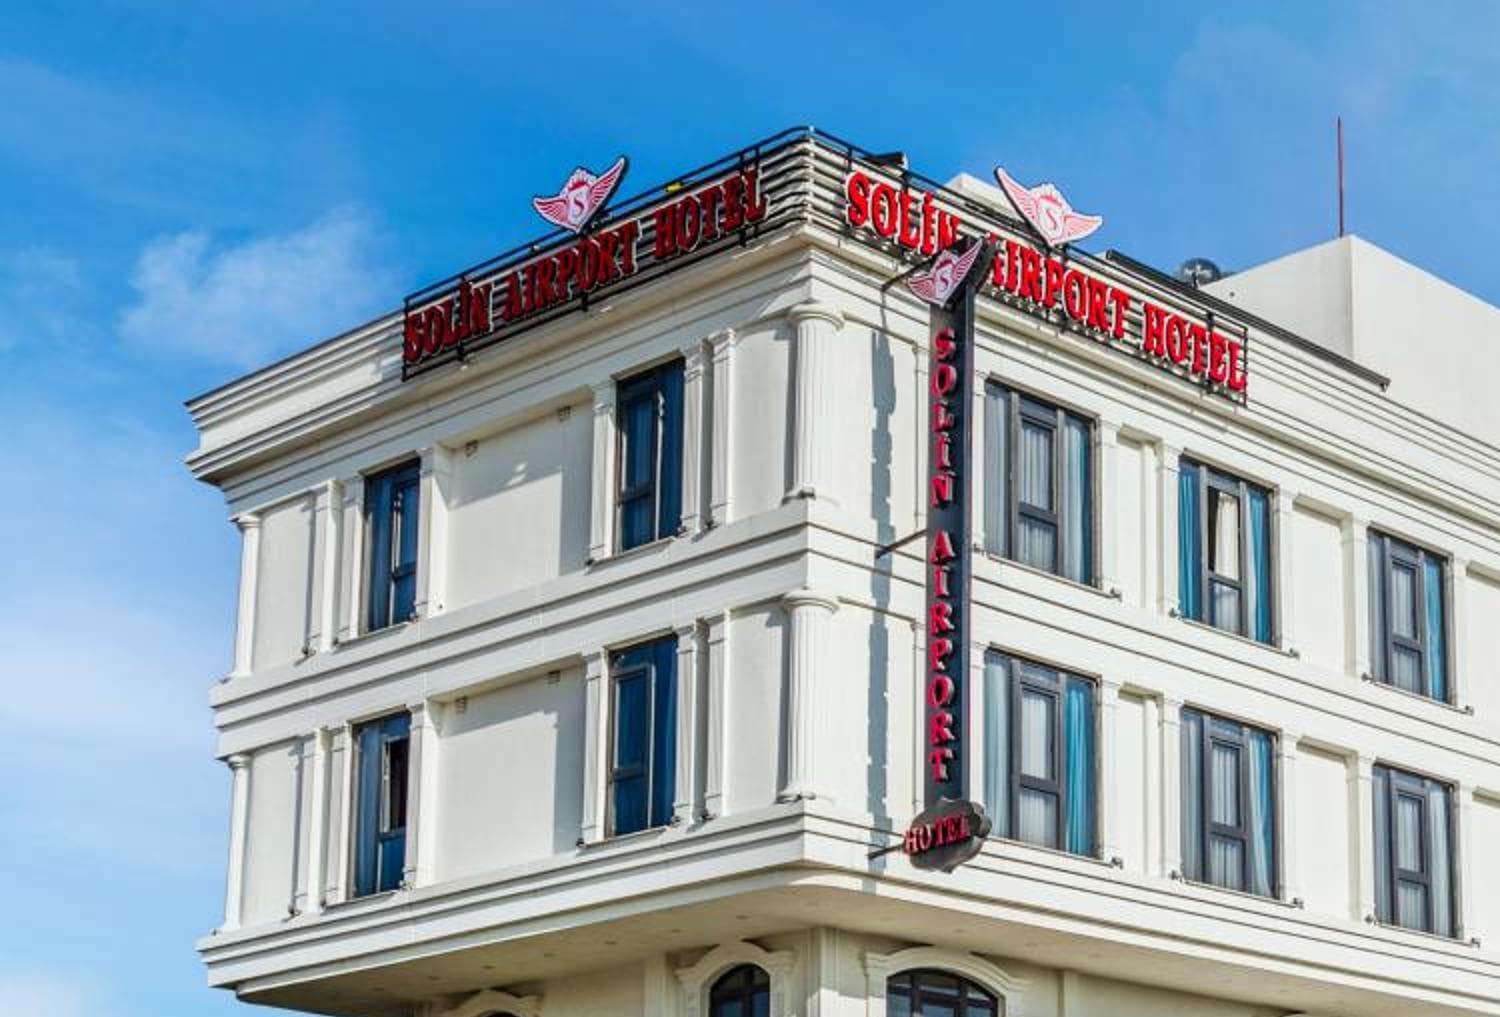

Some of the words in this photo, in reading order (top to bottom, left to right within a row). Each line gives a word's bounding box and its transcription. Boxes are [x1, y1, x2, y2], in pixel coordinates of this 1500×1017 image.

[502, 220, 641, 321] AIRPORT
[652, 168, 769, 260] HOTEL
[1142, 301, 1247, 393] HOTEL
[928, 529, 955, 783] AIRPORT
[903, 812, 971, 854] HOTEL
